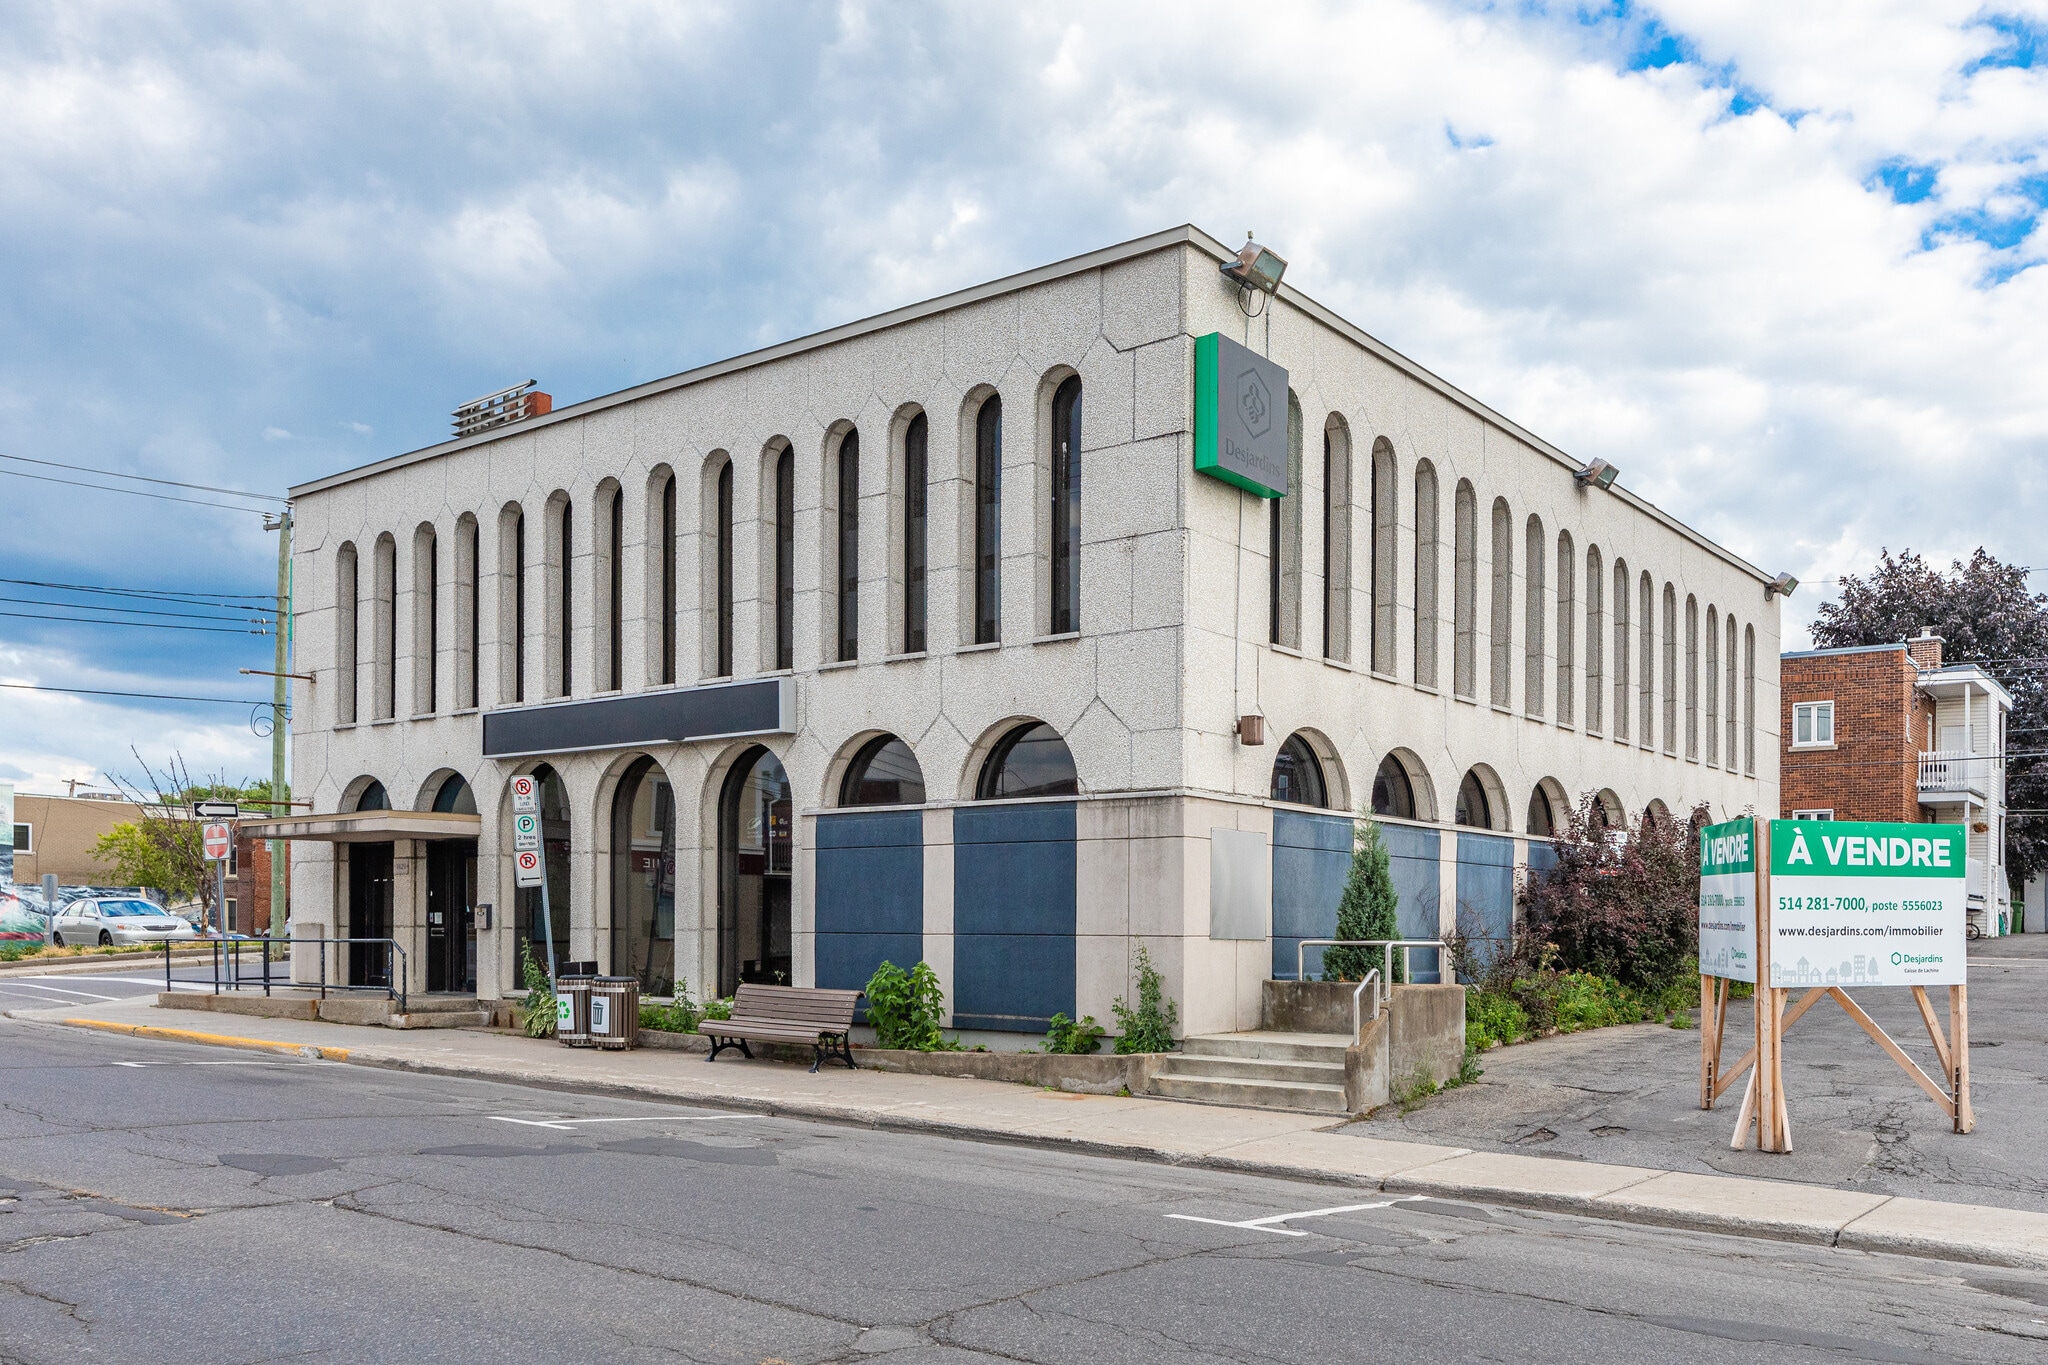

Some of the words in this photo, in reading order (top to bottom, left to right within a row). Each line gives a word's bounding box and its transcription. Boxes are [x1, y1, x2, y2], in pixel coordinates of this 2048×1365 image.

[1225, 437, 1281, 478] Desjardins
[522, 819, 531, 830] P
[1702, 834, 1709, 866] À
[1711, 832, 1749, 865] VENDRE
[1787, 827, 1813, 865] À
[1821, 835, 1951, 867] VENDRE
[1779, 896, 1803, 910] 514
[1806, 896, 1869, 913] 281-7000,
[1872, 900, 1898, 913] poste
[1902, 900, 1943, 911] 5556023
[1778, 925, 1944, 938] www.desjardins.com/immobilier
[1904, 954, 1943, 965] Desjardins
